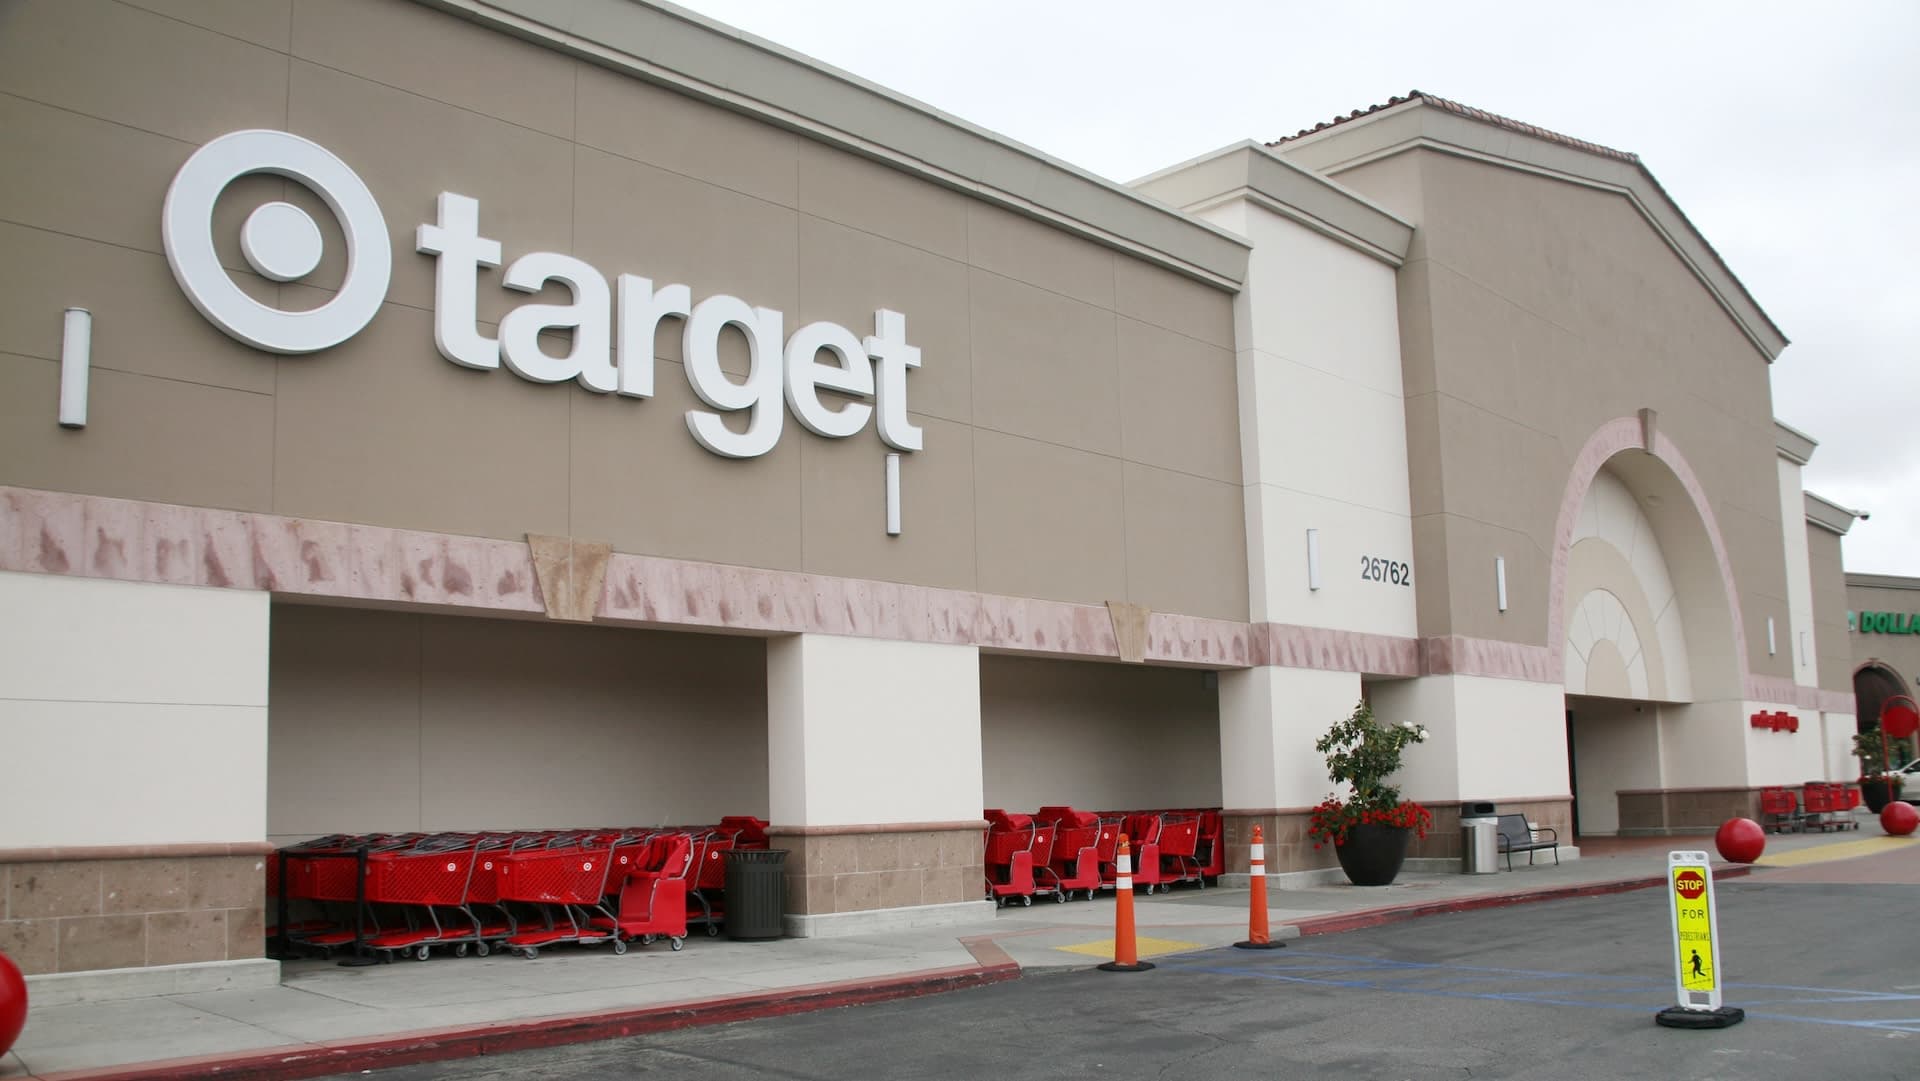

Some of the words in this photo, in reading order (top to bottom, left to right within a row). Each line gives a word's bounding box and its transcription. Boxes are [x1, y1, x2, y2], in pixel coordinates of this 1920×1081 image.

[416, 191, 923, 459] target
[1361, 555, 1410, 586] 26762
[1677, 880, 1704, 891] STOP
[1682, 909, 1705, 919] FOR
